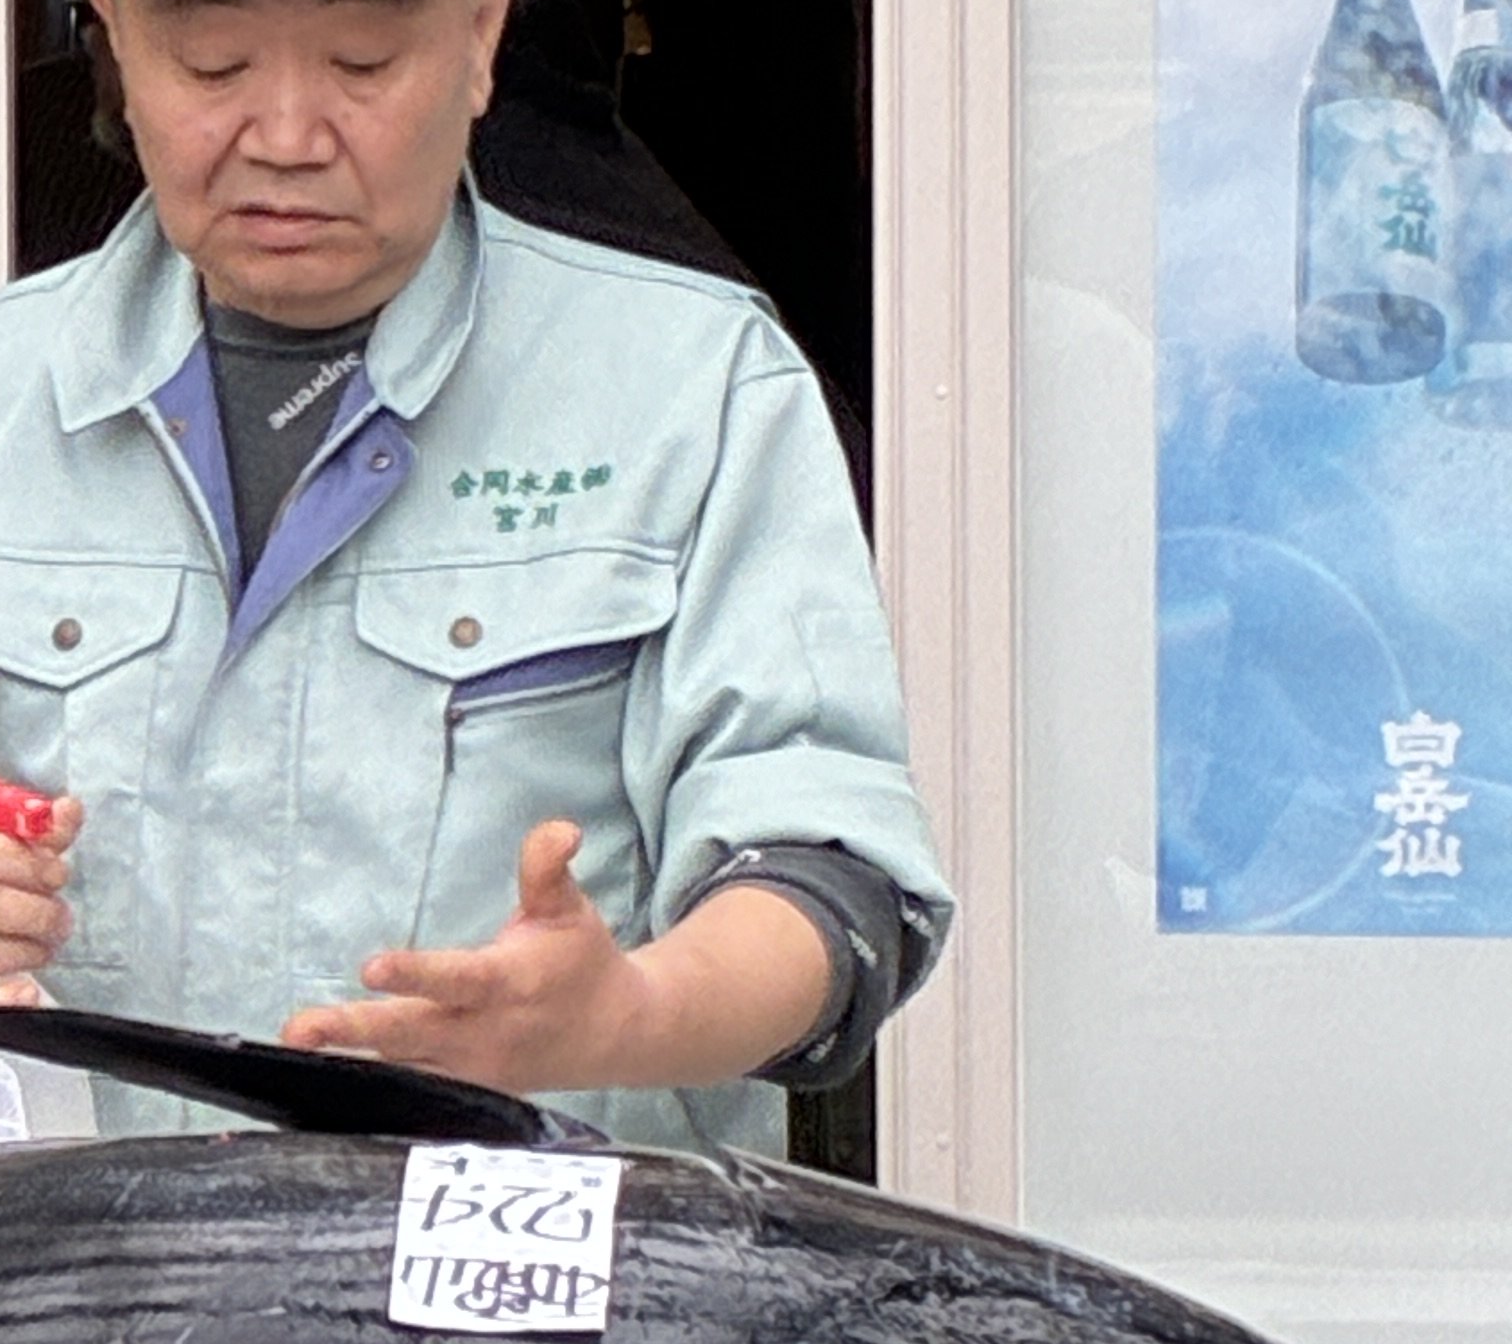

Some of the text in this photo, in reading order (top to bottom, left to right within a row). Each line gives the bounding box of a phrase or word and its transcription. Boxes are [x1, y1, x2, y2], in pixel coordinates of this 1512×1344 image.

[492, 503, 560, 533] 宮川
[1372, 709, 1472, 878] 白岳仙
